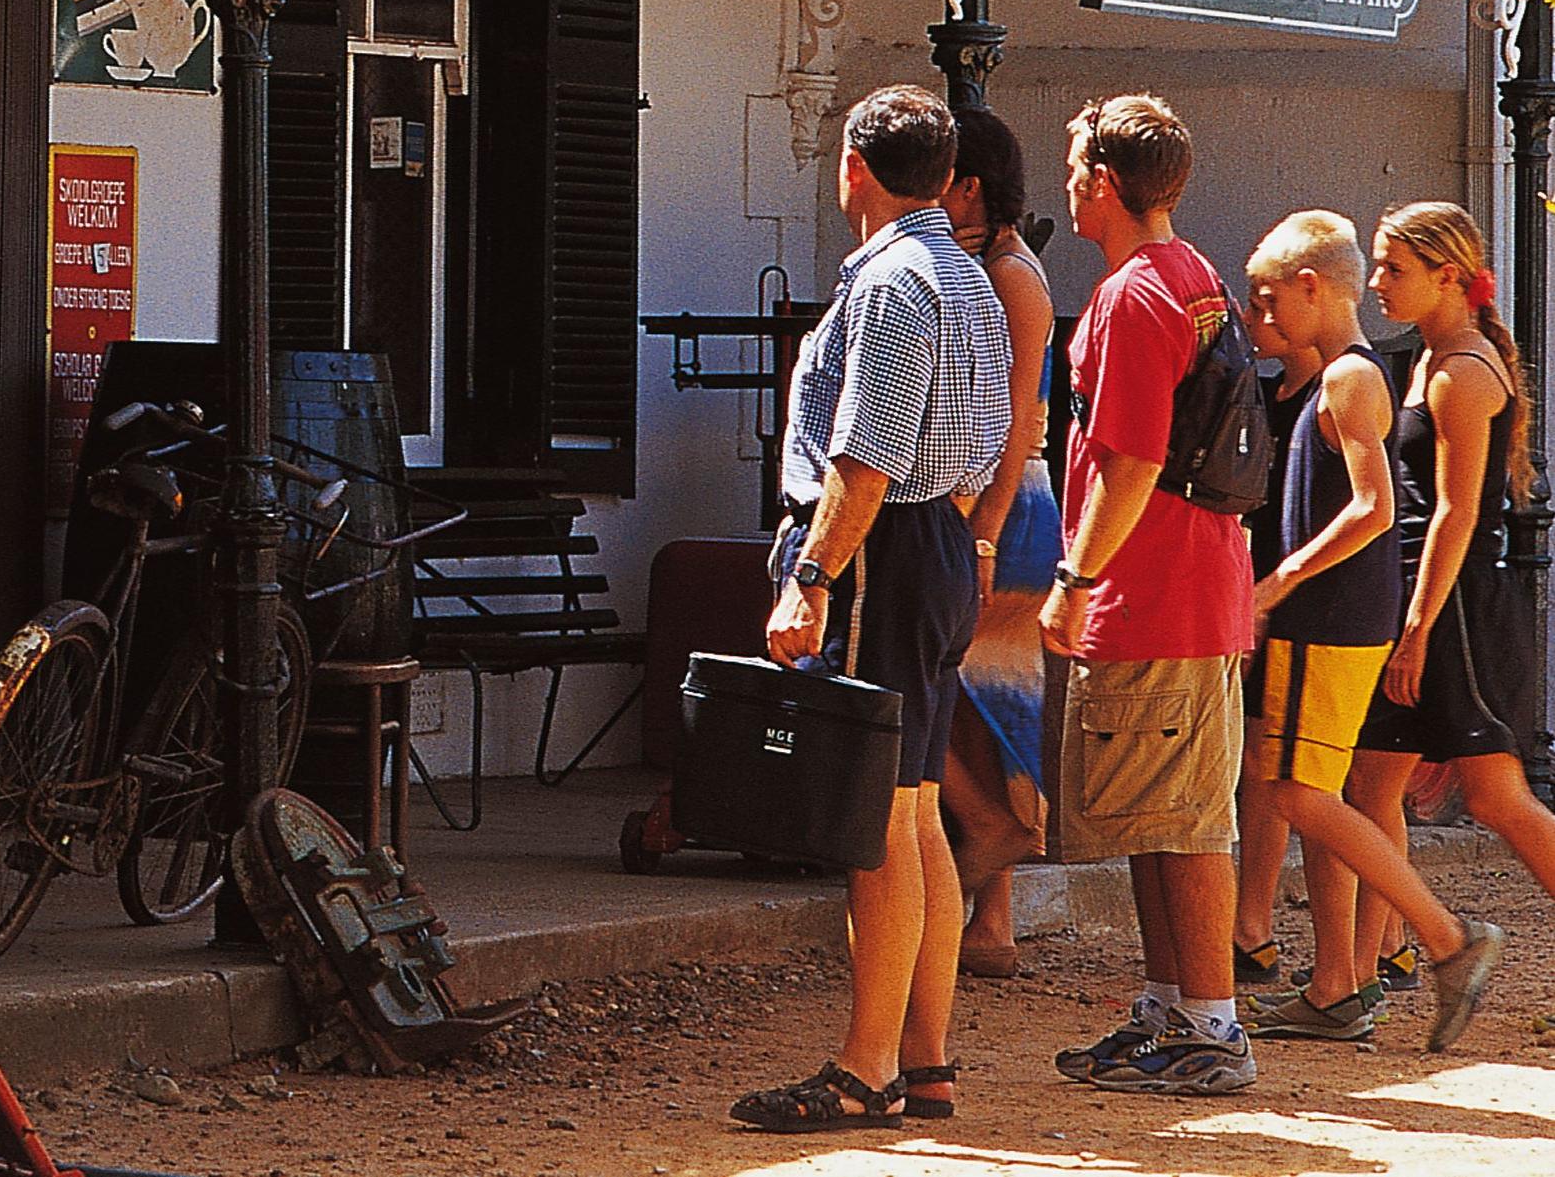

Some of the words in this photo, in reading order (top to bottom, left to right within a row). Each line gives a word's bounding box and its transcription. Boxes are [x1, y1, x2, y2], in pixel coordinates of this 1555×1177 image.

[59, 178, 125, 205] SKOOLGROEPE
[67, 204, 117, 228] WELKOM
[54, 243, 82, 265] GROEPE
[83, 244, 93, 265] VA
[79, 287, 108, 310] STRENG
[54, 352, 92, 377] SCHOLAR
